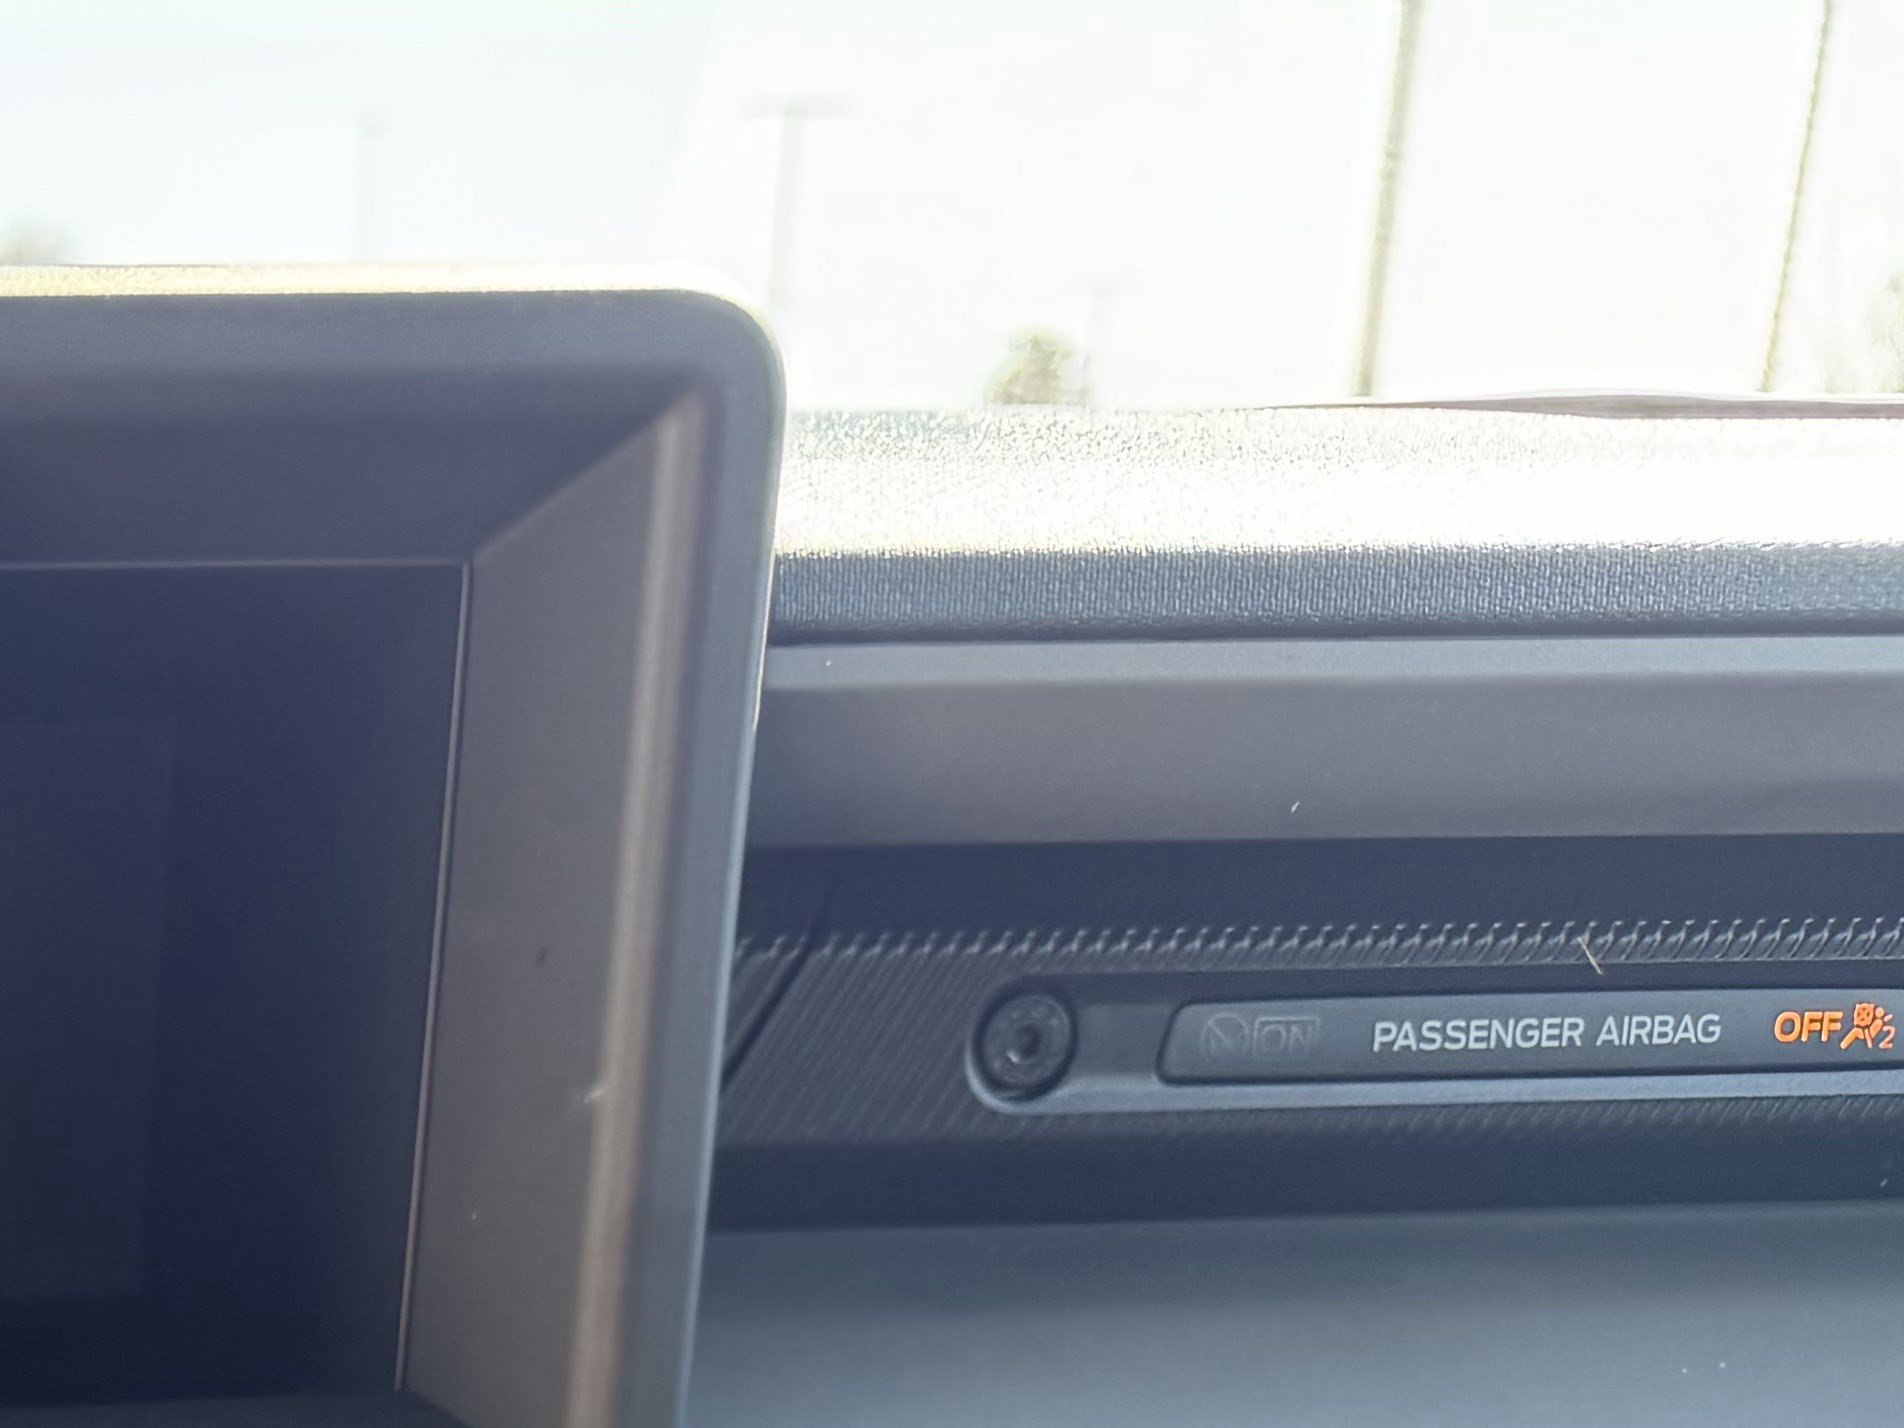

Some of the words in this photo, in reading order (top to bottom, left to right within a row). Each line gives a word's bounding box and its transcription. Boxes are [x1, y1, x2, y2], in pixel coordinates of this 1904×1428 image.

[1372, 1016, 1584, 1052] PASSENGER
[1596, 1014, 1722, 1047] AIRBAG
[1774, 1011, 1842, 1043] OFF
[1879, 1026, 1895, 1049] 2
